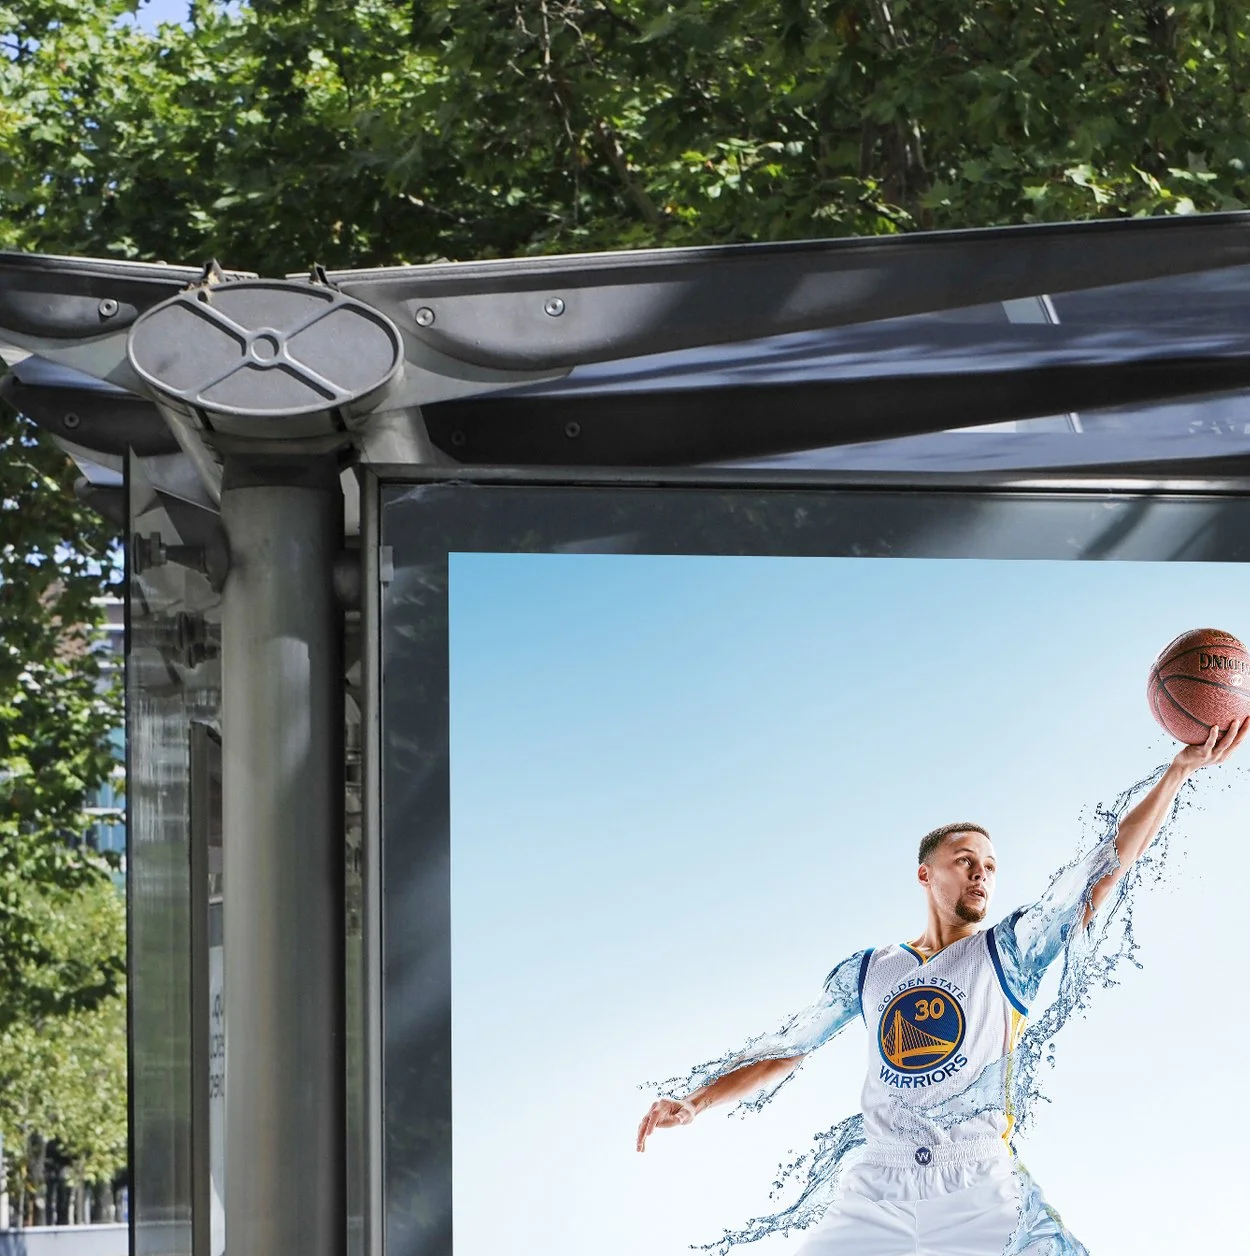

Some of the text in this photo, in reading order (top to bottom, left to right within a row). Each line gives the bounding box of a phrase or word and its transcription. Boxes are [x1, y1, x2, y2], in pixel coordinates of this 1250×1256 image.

[877, 976, 967, 1013] GOLDEN STATE
[914, 997, 945, 1021] 30
[879, 1053, 968, 1089] WARRIORS
